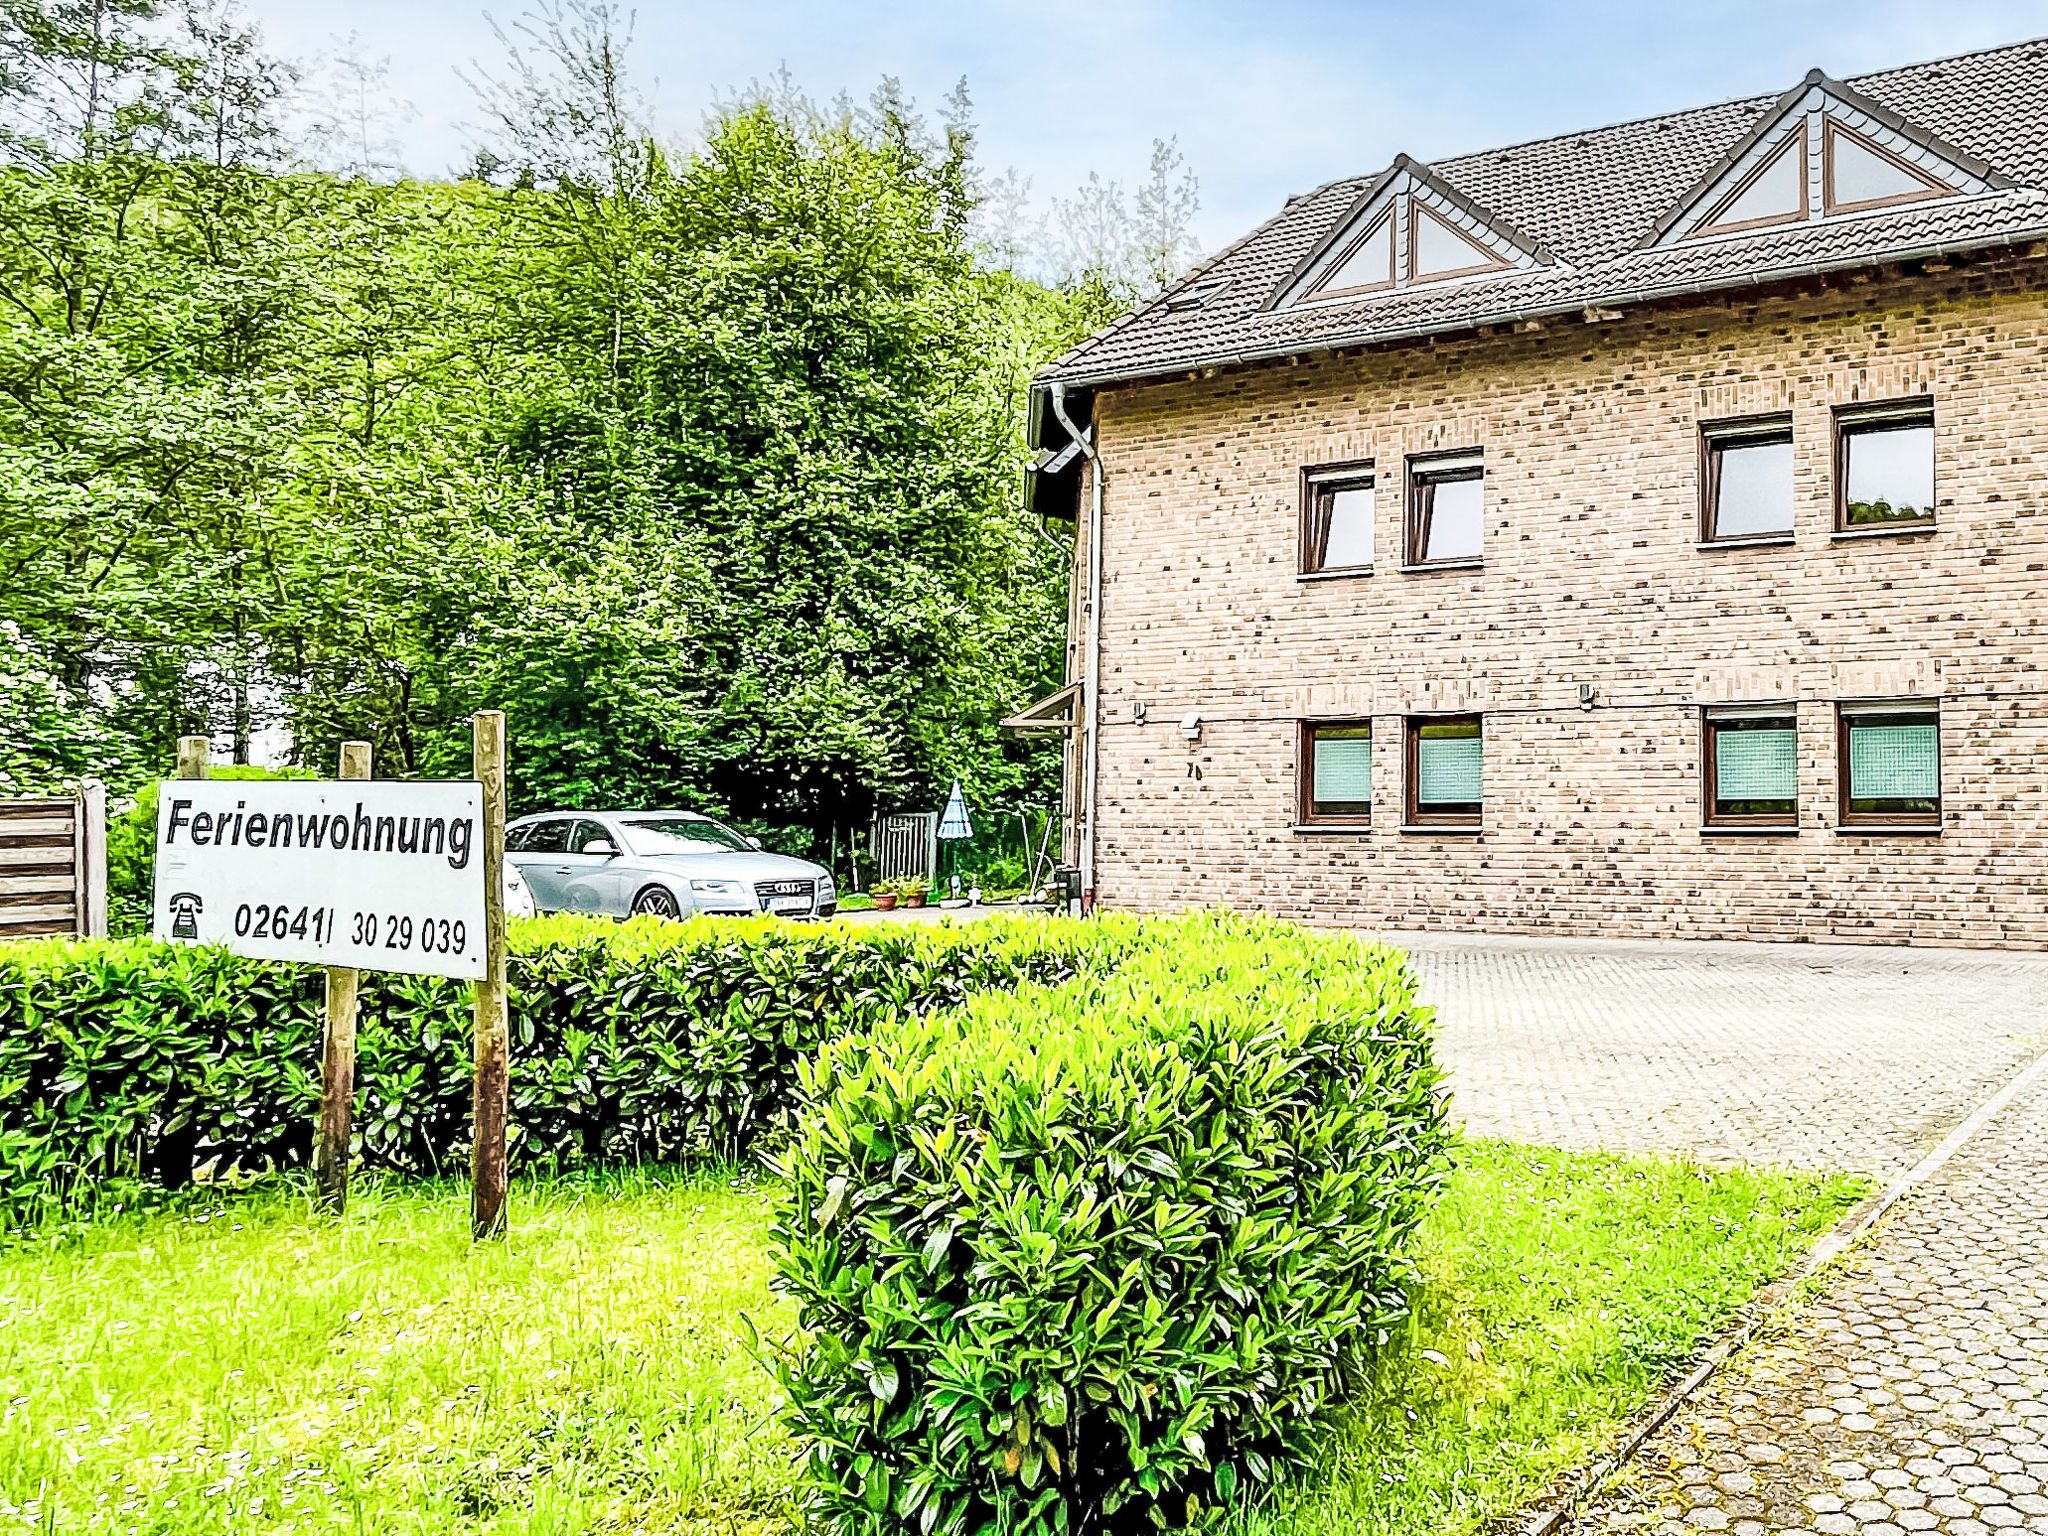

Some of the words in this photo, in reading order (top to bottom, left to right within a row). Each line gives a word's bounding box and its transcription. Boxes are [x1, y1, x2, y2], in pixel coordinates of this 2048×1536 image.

[165, 799, 473, 870] Ferienwohnung
[351, 911, 377, 947] 30
[384, 914, 413, 951] 29
[421, 917, 466, 955] 039
